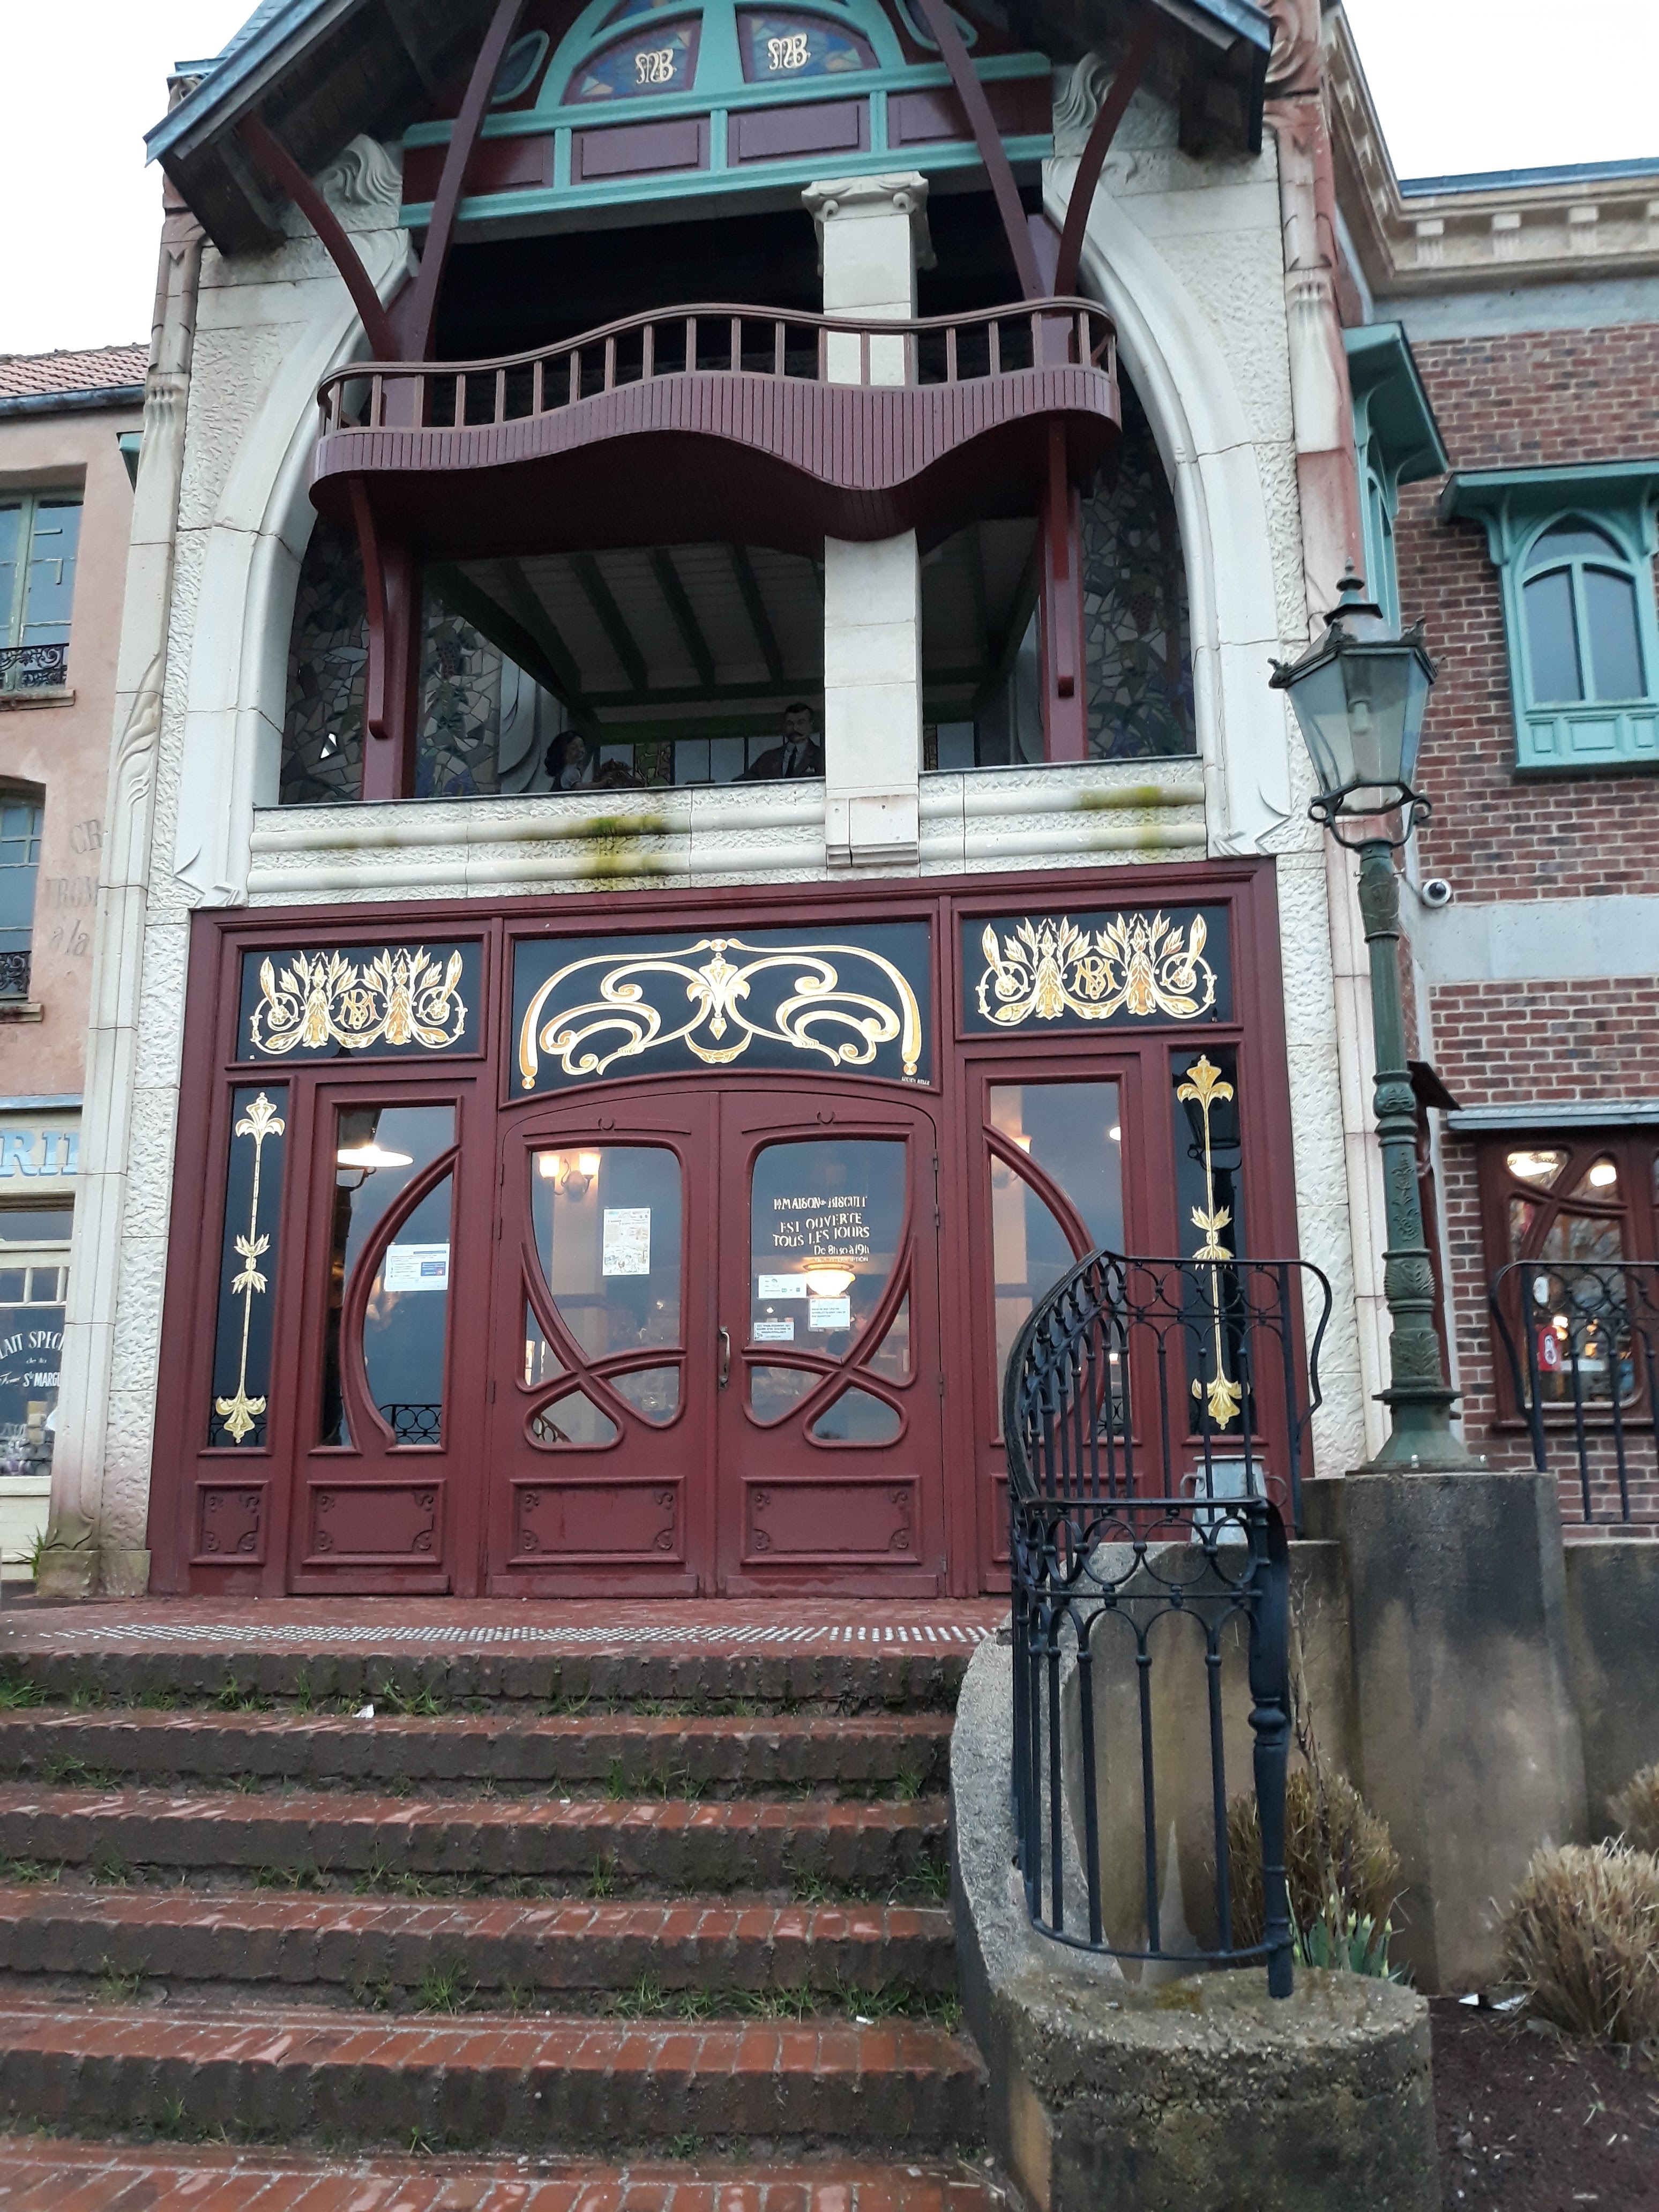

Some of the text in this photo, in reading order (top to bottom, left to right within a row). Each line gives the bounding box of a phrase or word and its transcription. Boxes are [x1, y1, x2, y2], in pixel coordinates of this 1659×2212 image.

[781, 1197, 820, 1209] MAISON
[827, 1195, 868, 1208] BISCUIT
[780, 1212, 862, 1233] EST OUVERTE
[772, 1225, 870, 1247] TOUS LES JOURS
[814, 1245, 826, 1256] De
[855, 1243, 870, 1256] 19h
